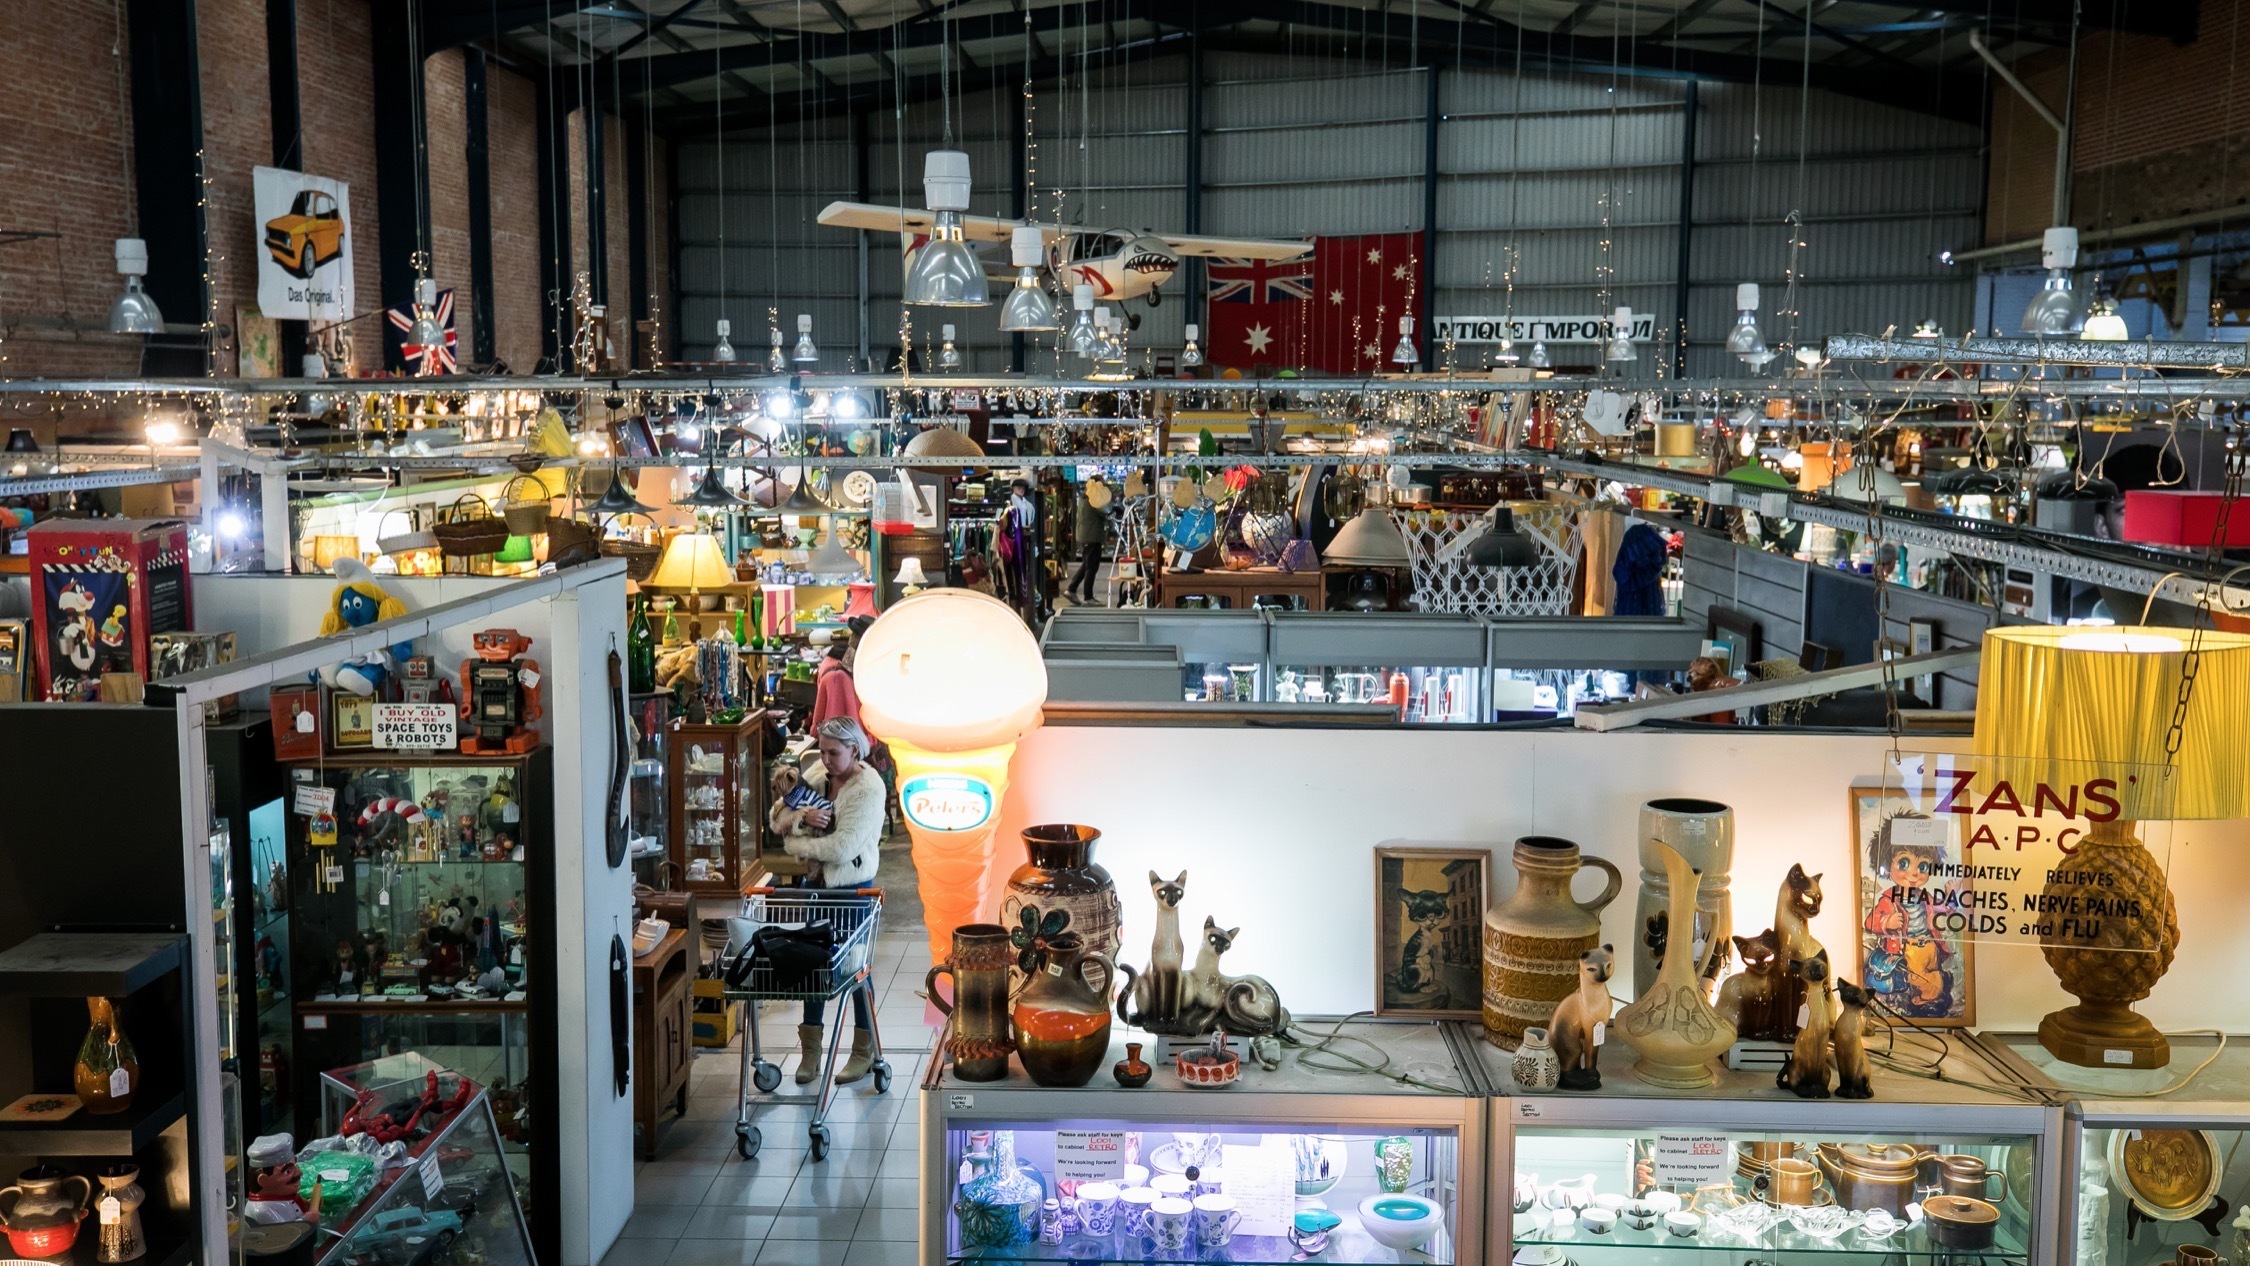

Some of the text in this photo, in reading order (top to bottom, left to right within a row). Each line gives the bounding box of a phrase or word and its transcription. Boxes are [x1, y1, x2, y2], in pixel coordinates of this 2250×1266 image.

[288, 287, 303, 302] Das
[377, 723, 453, 733] SPACE TOYS
[385, 734, 447, 743] & ROBOTS
[1927, 863, 2114, 887] IMMEDIATELY RELIEVES
[2023, 893, 2079, 914] NERVE
[1932, 912, 2100, 939] COLDS and FLU
